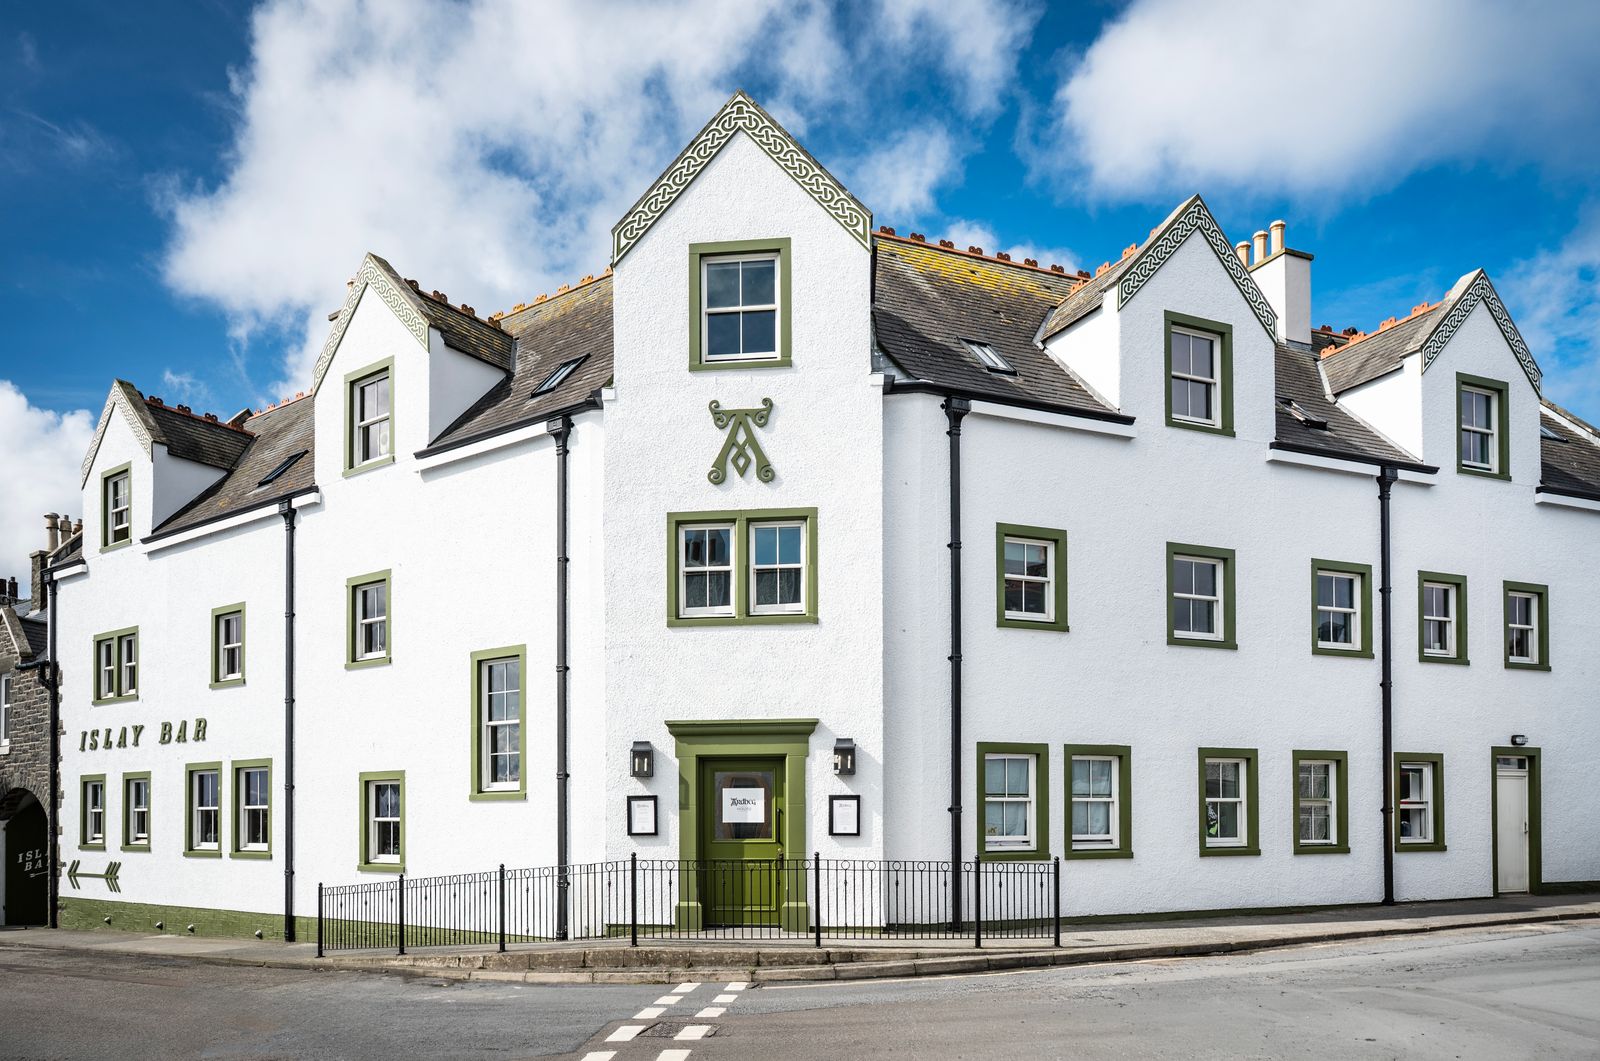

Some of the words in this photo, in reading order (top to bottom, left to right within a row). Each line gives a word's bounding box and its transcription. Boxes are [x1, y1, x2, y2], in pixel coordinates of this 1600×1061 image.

[79, 724, 144, 752] ISLAY
[159, 717, 207, 745] BAR
[17, 849, 48, 863] ISL
[24, 859, 49, 871] BA
